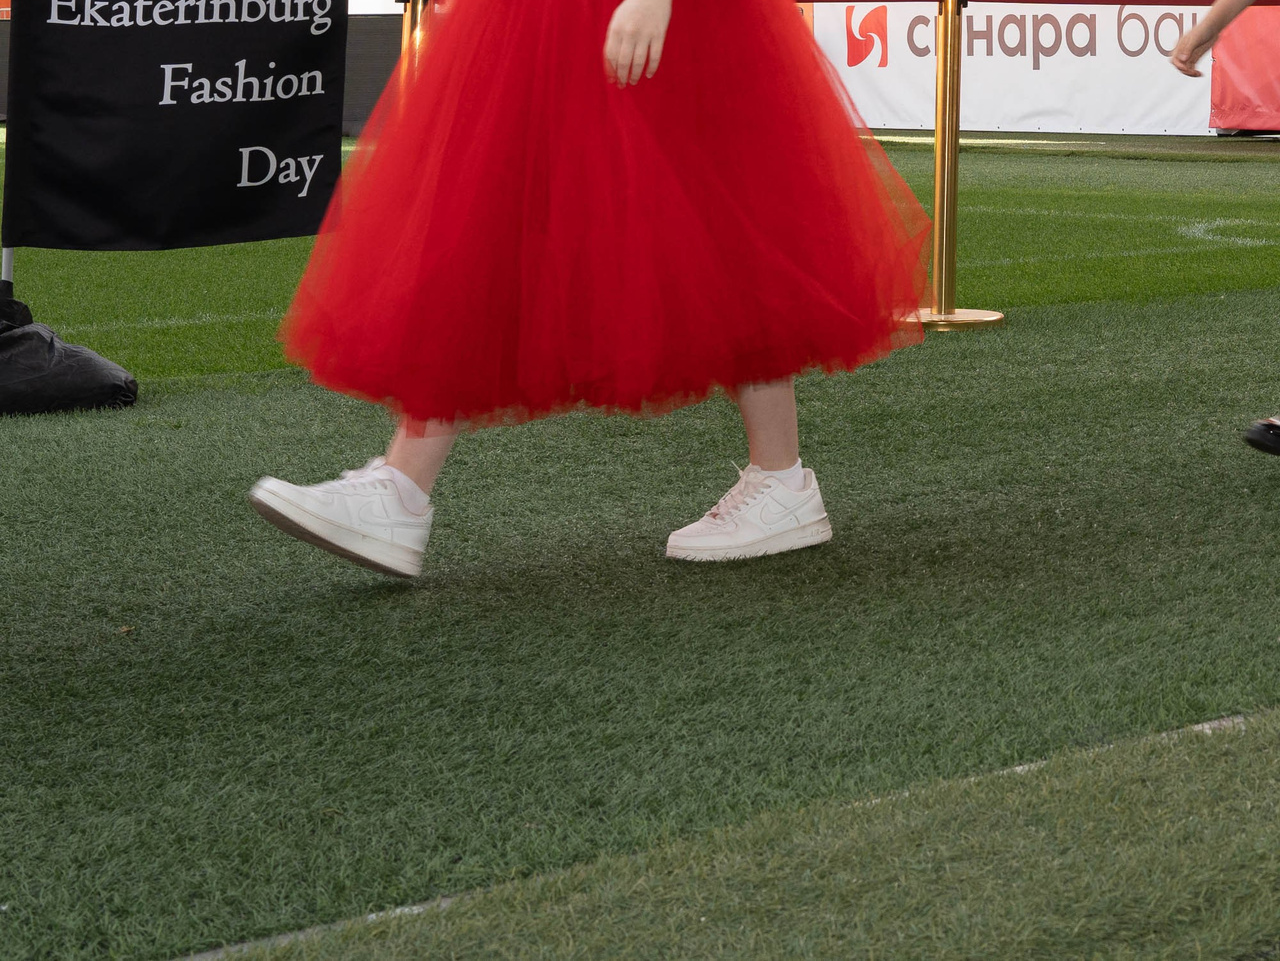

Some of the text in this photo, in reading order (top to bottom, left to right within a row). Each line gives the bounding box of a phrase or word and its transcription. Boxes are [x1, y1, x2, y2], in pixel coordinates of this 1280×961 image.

[907, 13, 1097, 70] снара
[158, 59, 325, 105] Fashion
[237, 146, 324, 198] Day
